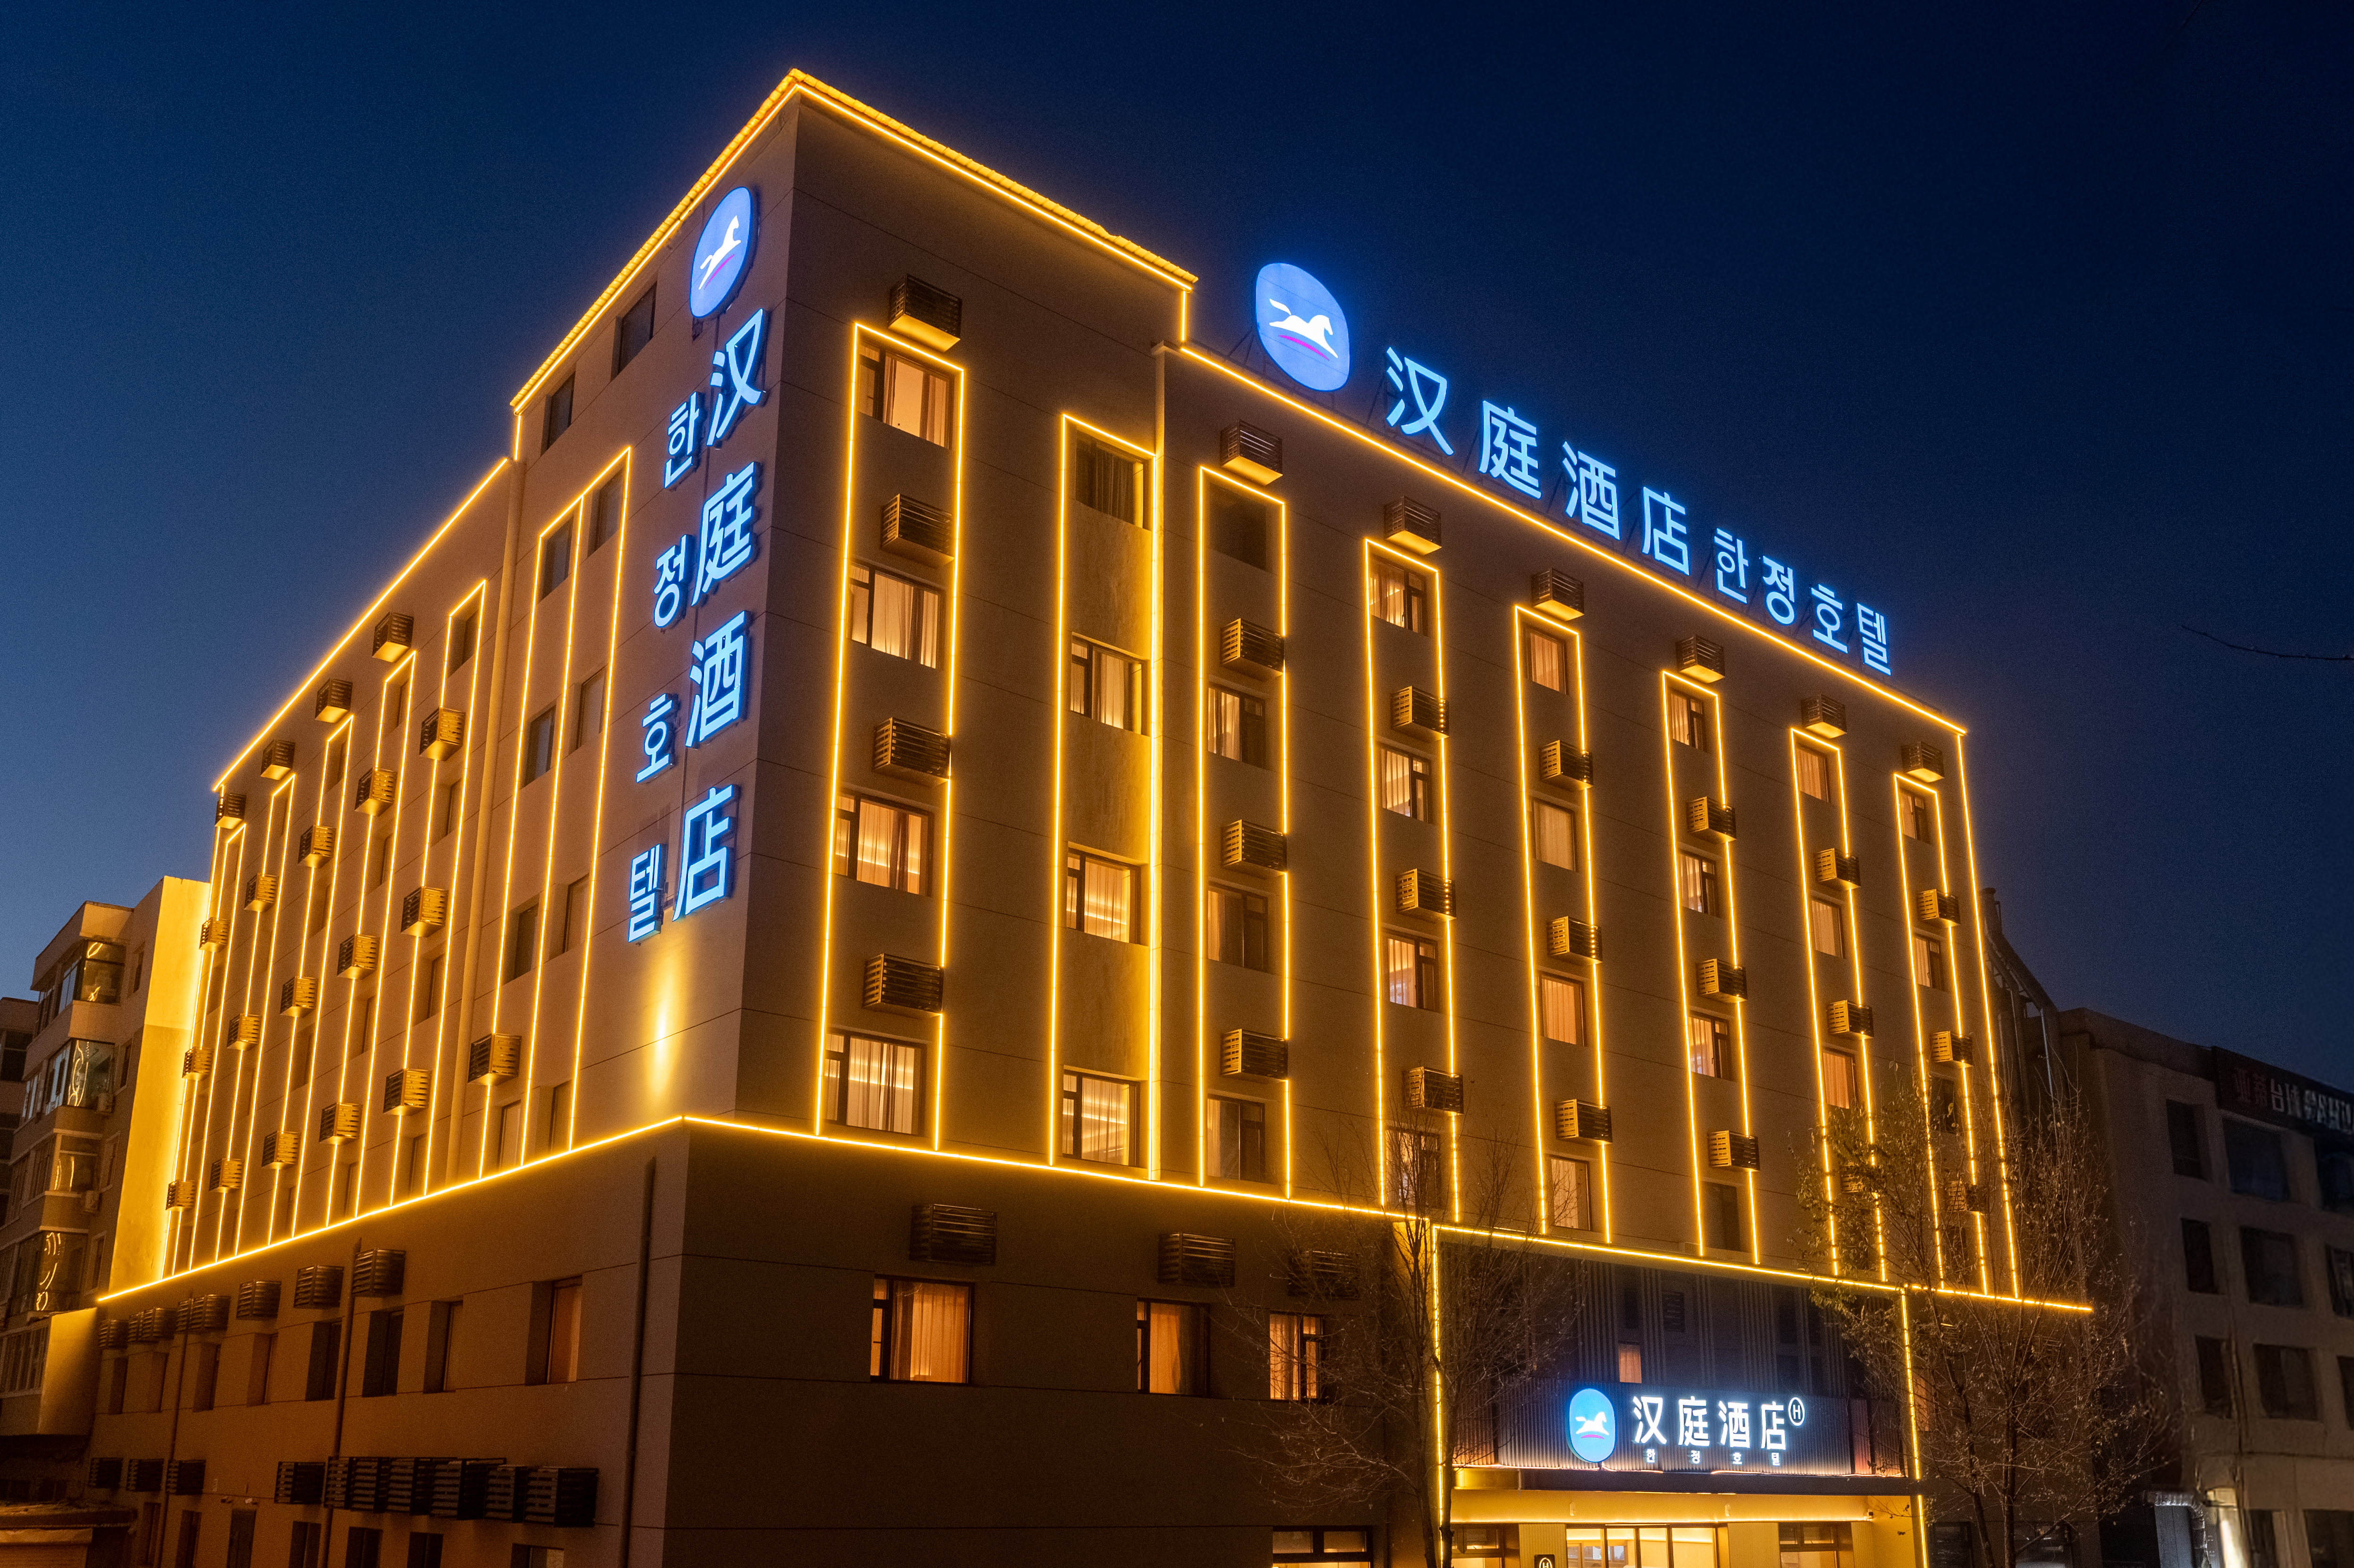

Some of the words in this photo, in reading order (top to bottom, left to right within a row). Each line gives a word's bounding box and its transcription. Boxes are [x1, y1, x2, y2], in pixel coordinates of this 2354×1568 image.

[628, 391, 700, 942] 한정호텔
[672, 308, 763, 922] 汉庭酒店
[1385, 346, 1691, 576] 汉庭酒店
[1714, 528, 1892, 676] 한정호텔
[1632, 1395, 1786, 1450] 汉庭酒店
